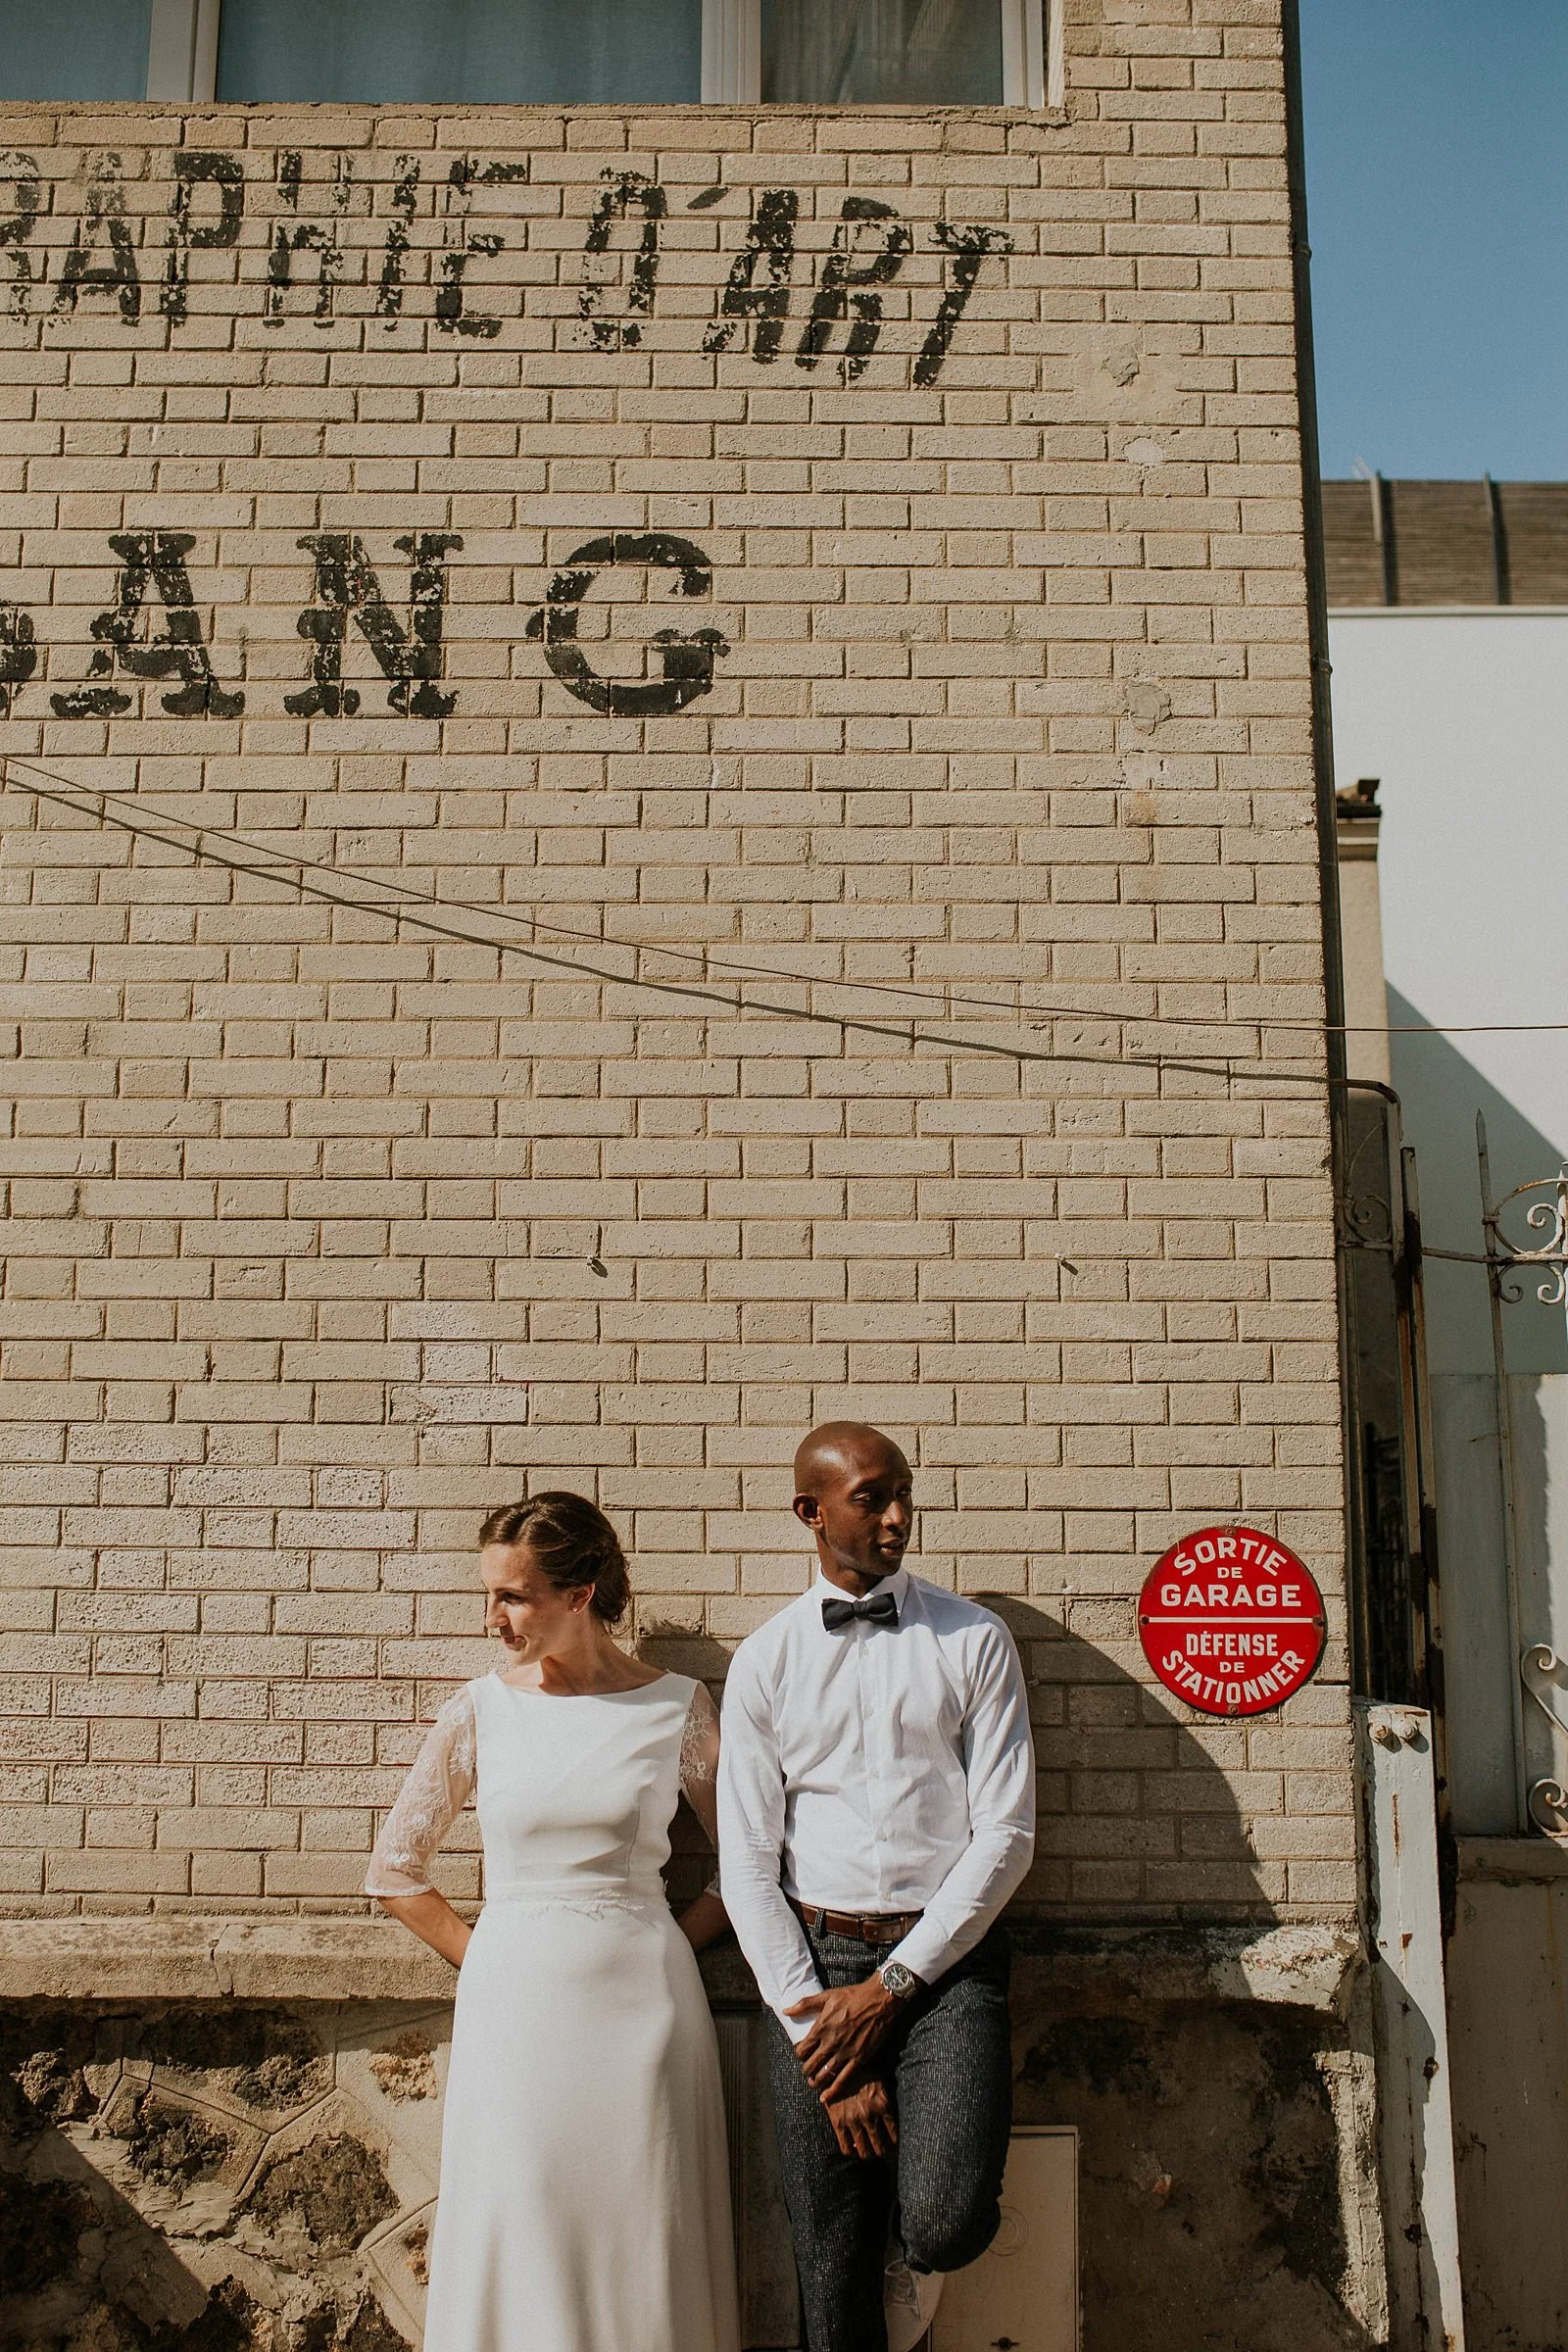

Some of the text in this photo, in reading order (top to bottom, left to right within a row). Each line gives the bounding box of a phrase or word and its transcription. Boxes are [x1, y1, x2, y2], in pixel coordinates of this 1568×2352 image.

[0, 532, 730, 718] ANG
[1173, 1536, 1288, 1577] SORTIE
[1216, 1566, 1244, 1579] DE
[1160, 1584, 1301, 1607] GARAGE
[1186, 1631, 1279, 1657] DÉFENSE
[1162, 1649, 1305, 1704] STATIONNER
[1219, 1661, 1246, 1674] DE
